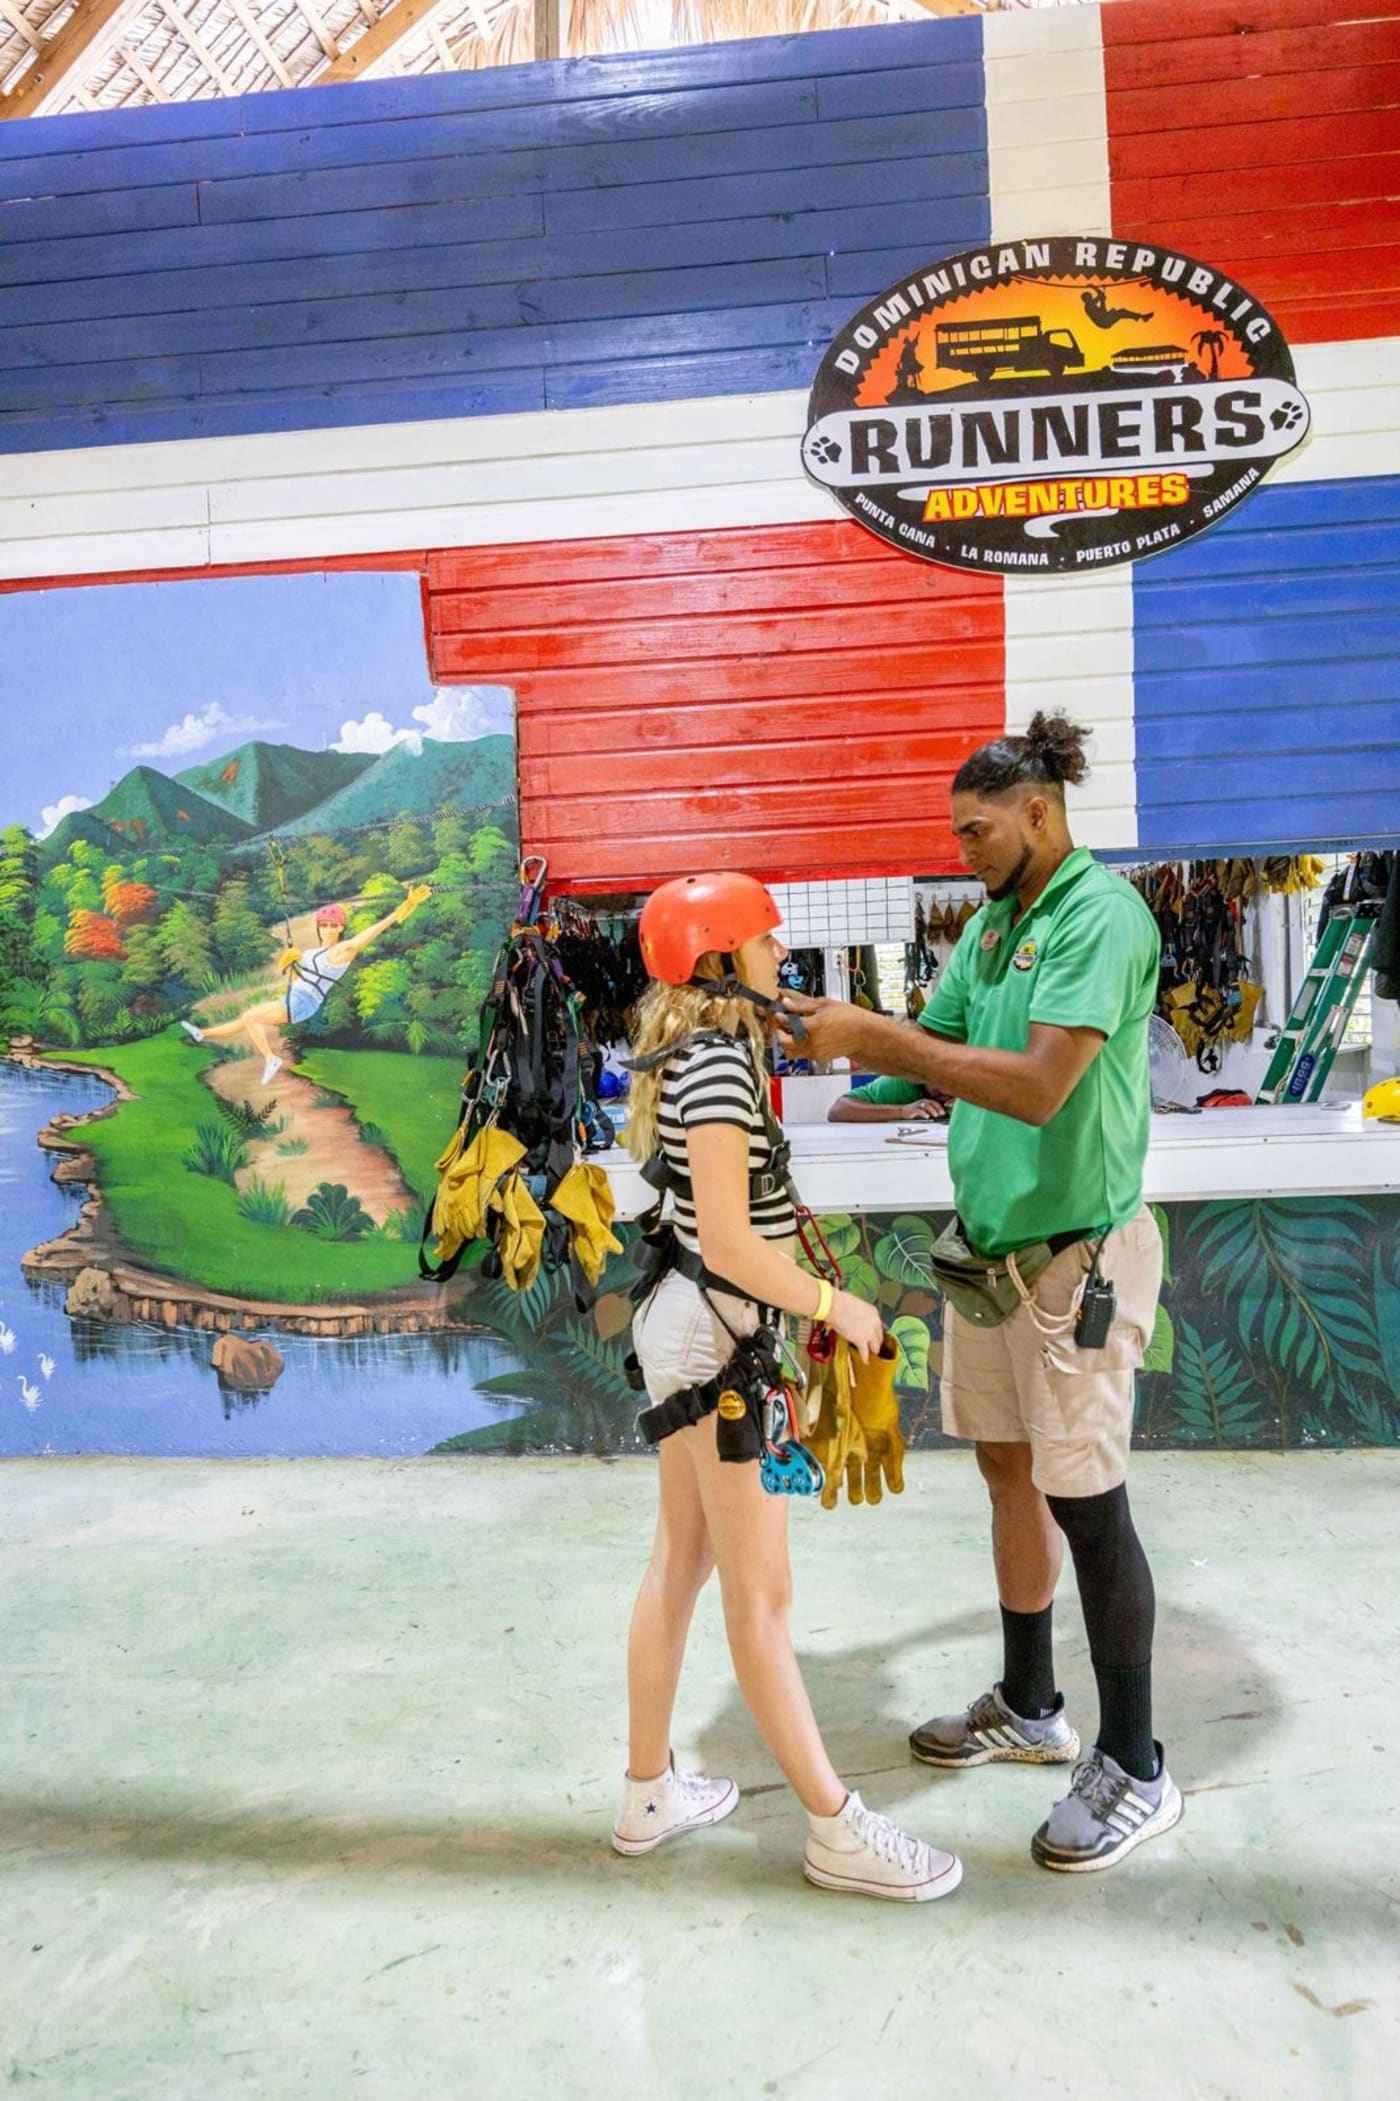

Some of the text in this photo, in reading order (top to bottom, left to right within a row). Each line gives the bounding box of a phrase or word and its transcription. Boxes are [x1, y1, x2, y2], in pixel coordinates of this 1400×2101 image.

[834, 242, 1271, 375] DOMINICAN REPUBLIC
[849, 390, 1265, 475] RUNNERS
[855, 467, 1260, 566] PUNTA CANA LA ROMANA PUERTO PLATA SAMANA
[923, 474, 1190, 522] ADVENTURES
